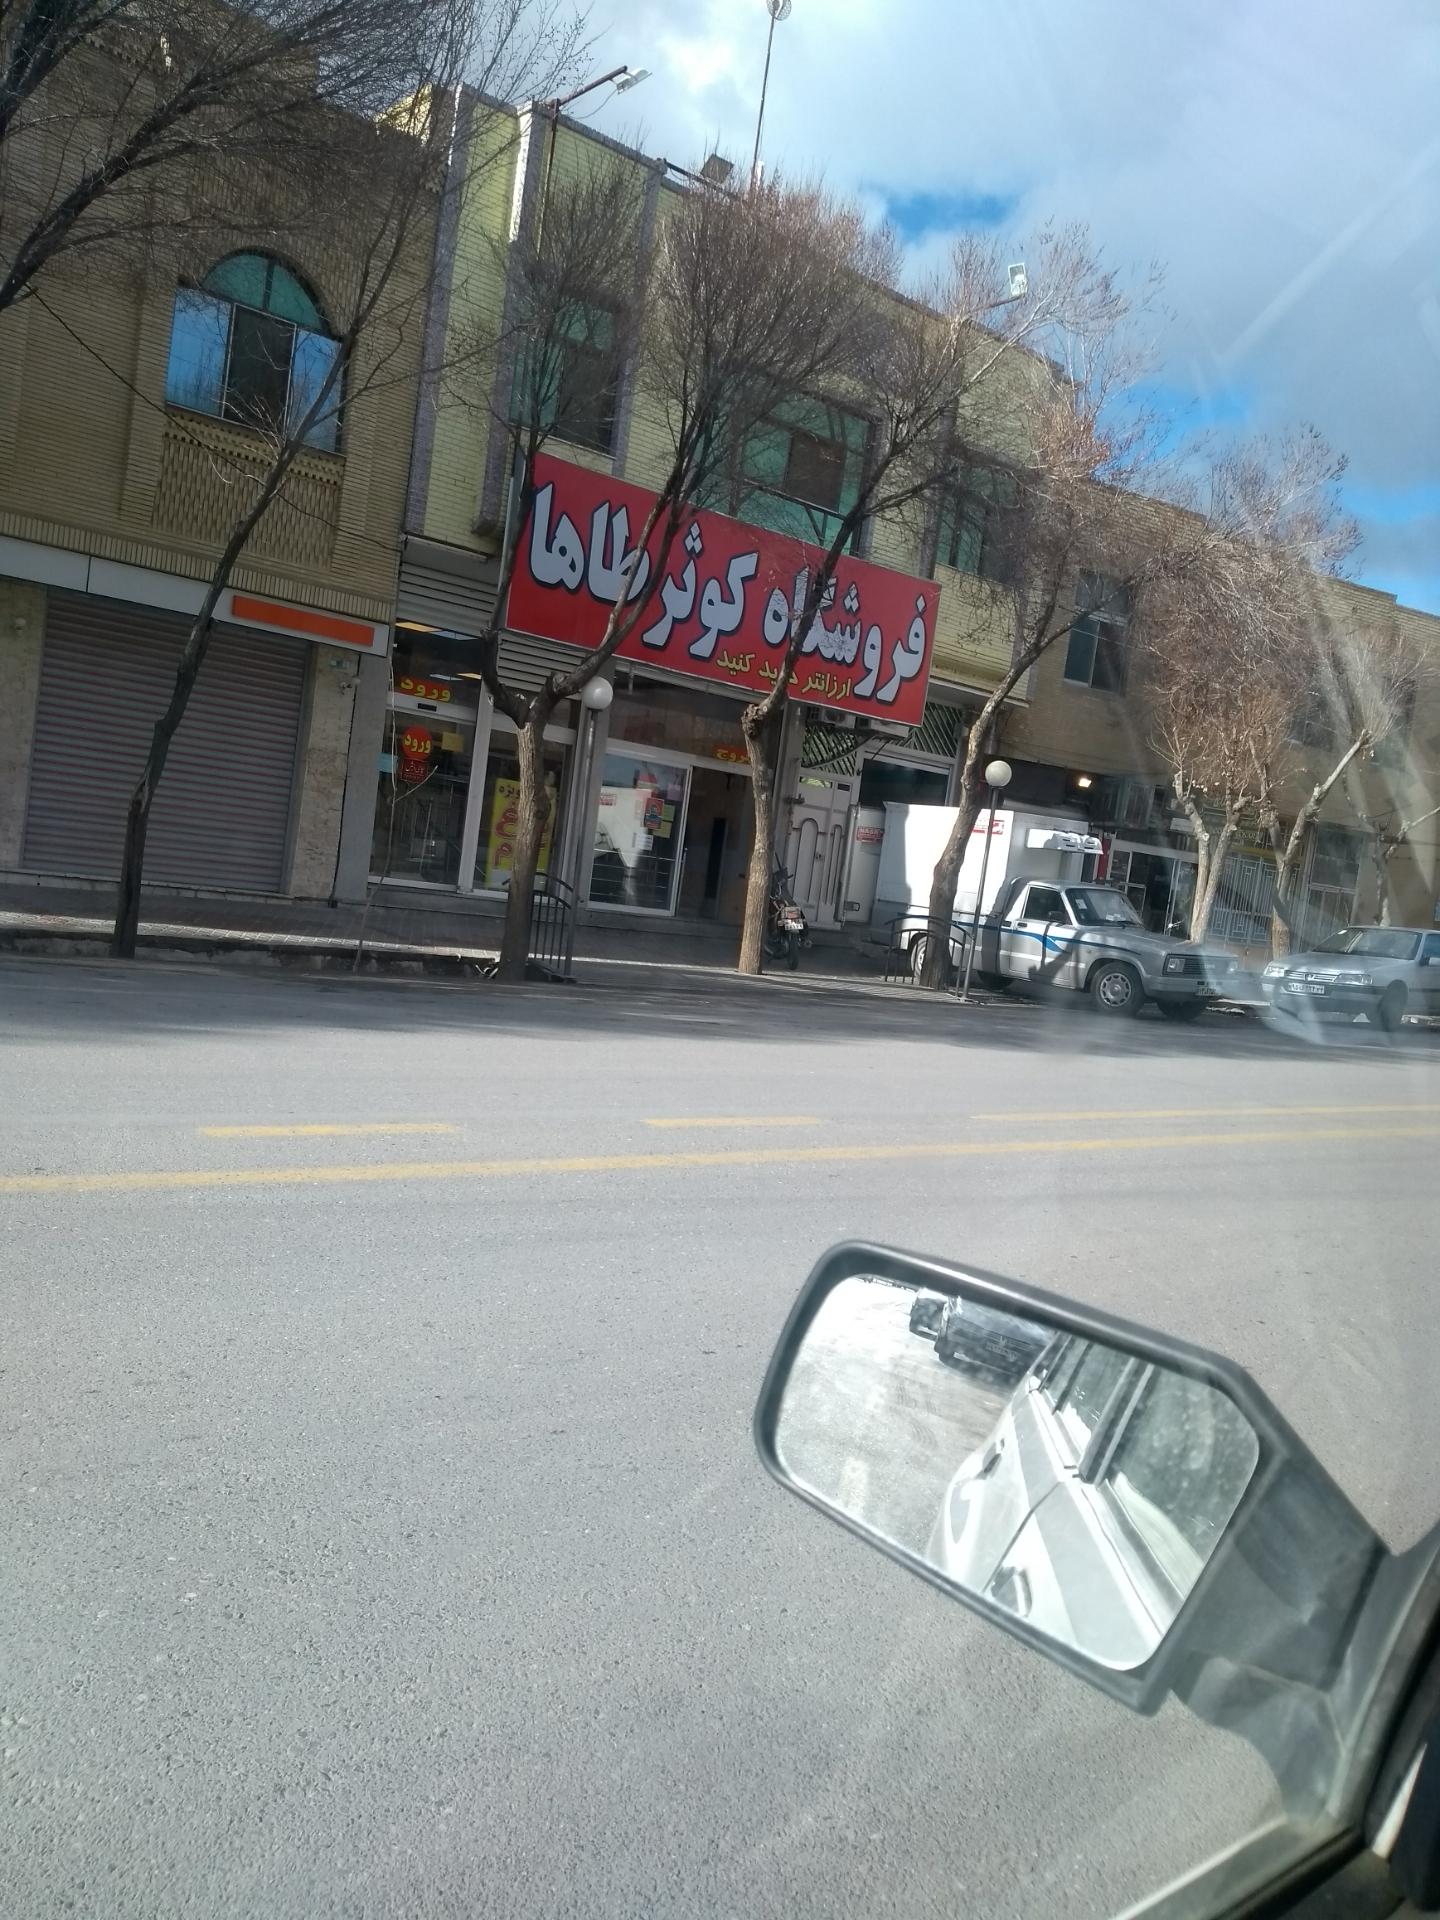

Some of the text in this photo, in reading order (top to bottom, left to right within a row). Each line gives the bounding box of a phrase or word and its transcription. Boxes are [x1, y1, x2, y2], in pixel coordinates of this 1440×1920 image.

[528, 481, 928, 704] فروشگاه کوثر طاها
[716, 649, 756, 677] کنید
[400, 677, 452, 702] ورود
[801, 671, 852, 700] ارزانتر
[403, 733, 432, 754] ورود
